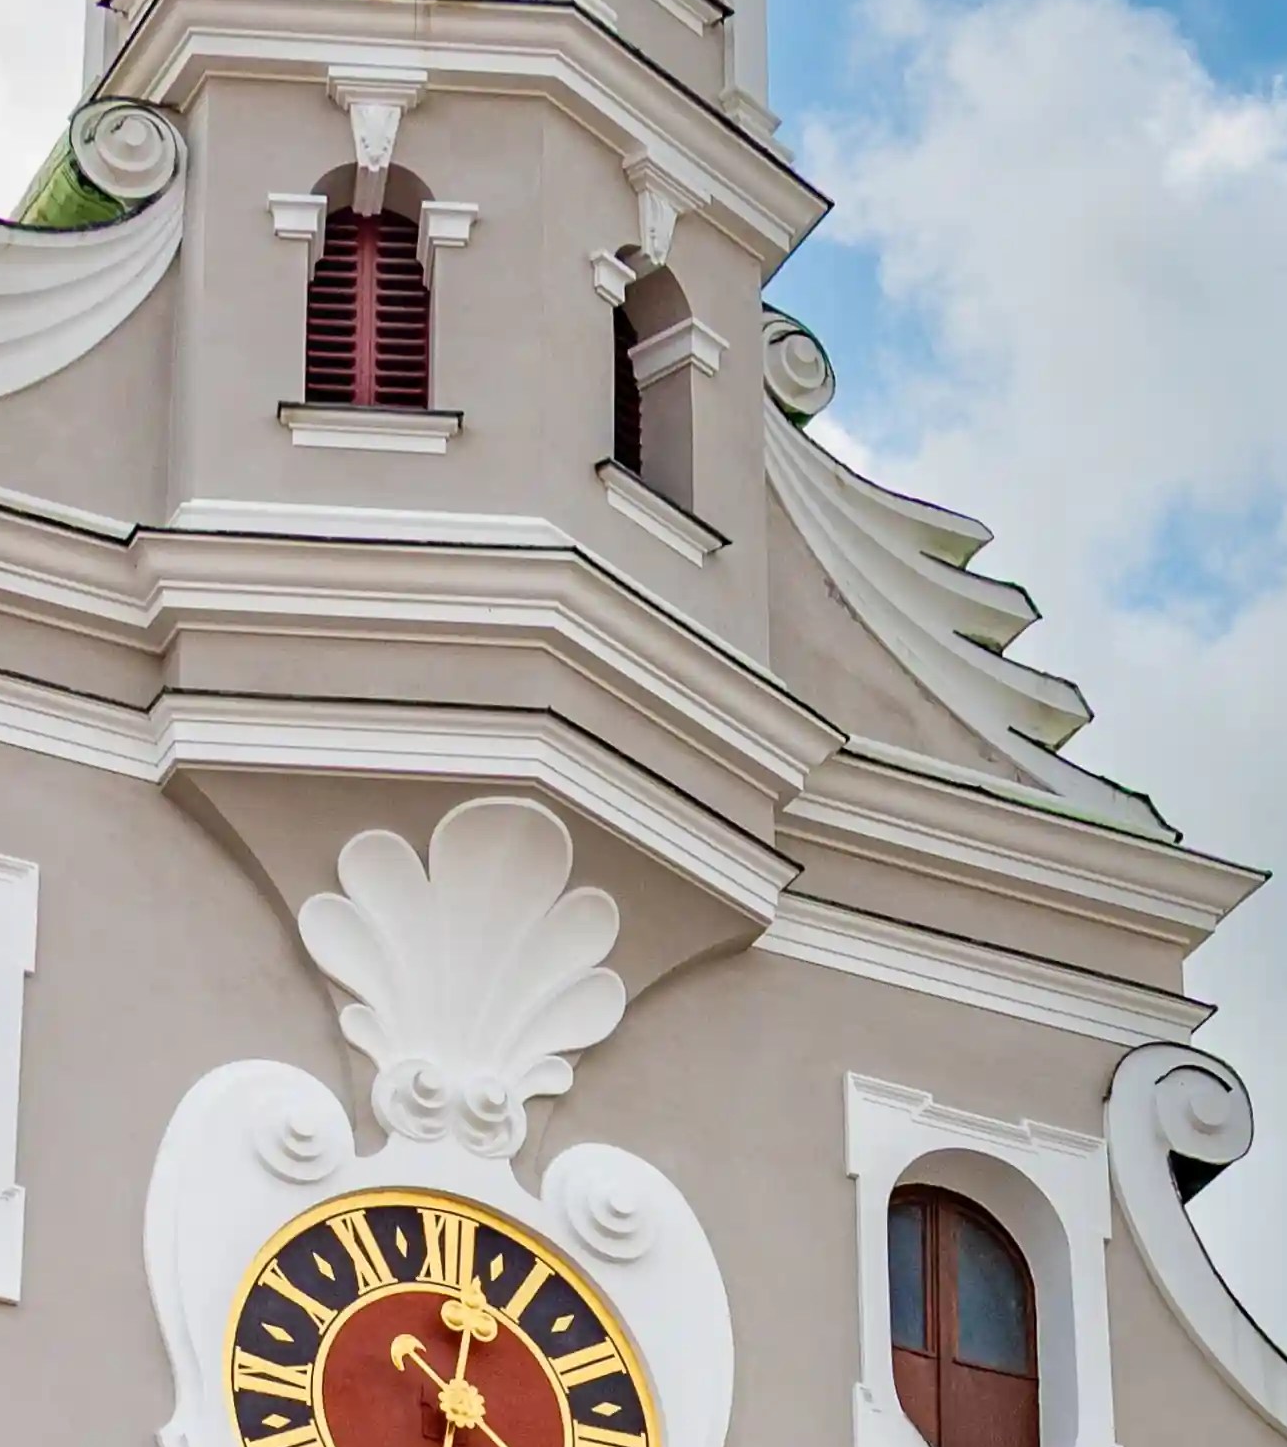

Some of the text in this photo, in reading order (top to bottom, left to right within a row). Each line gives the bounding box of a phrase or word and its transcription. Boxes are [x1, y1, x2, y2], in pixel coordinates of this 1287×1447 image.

[325, 1209, 398, 1295] XI
[416, 1207, 479, 1288] XII
[259, 1258, 339, 1335] X
[500, 1257, 556, 1325] I
[234, 1346, 313, 1407] IX
[548, 1336, 628, 1394] II
